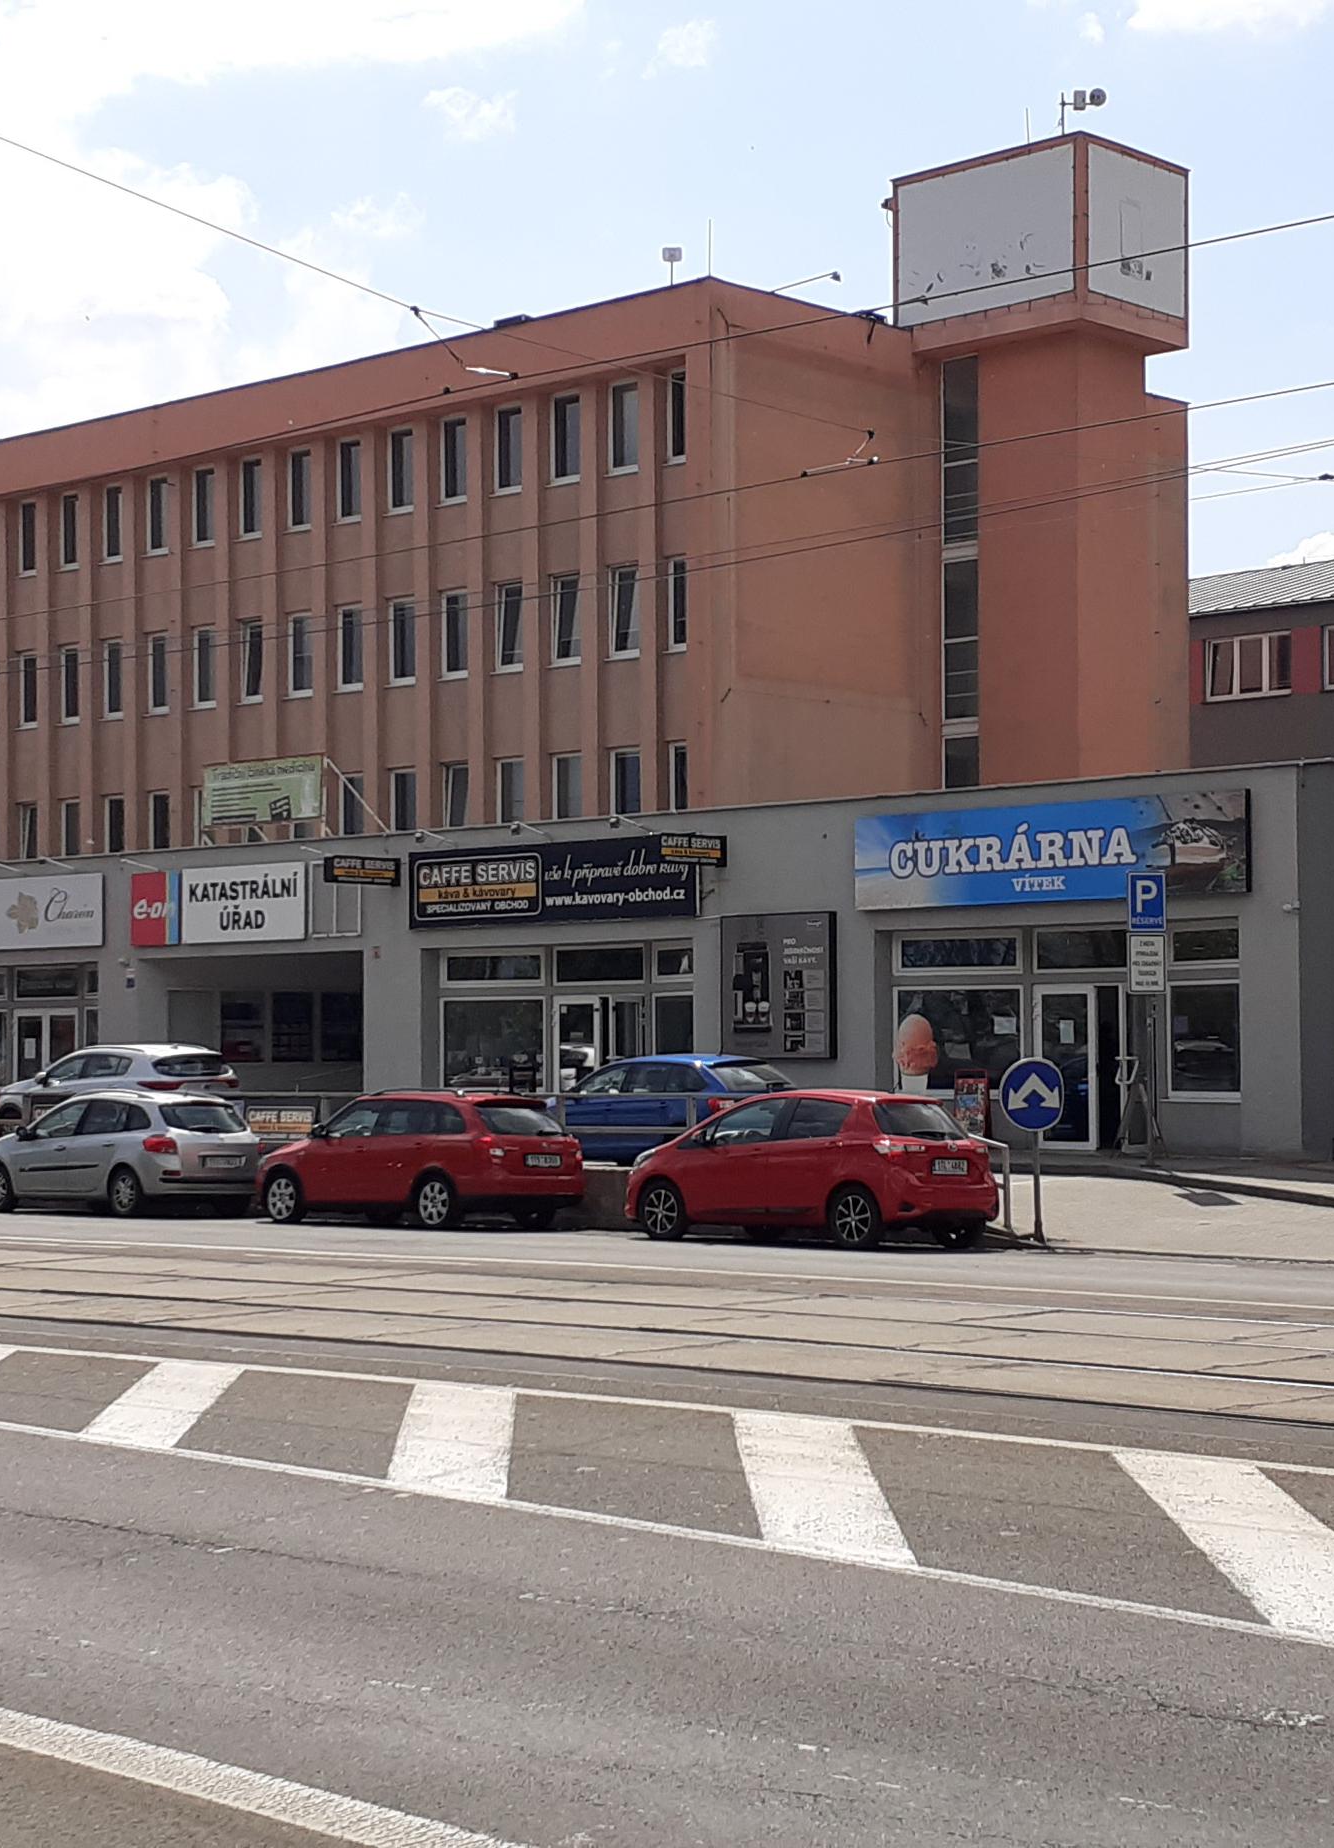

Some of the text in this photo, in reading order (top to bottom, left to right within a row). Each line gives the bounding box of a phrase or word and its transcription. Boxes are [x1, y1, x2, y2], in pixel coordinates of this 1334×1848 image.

[661, 836, 721, 849] CAFFE SERVIS
[889, 821, 1137, 878] CUKRÁRNA
[334, 858, 362, 869] CAFFE
[418, 860, 536, 887] CAFFE SERVIS
[1011, 874, 1066, 892] VÍTEK
[188, 871, 299, 903] KATASTRÁLNÍ
[438, 888, 460, 899] káva
[472, 886, 517, 900] kávovary
[545, 886, 686, 907] www.kavovary-obchod.cz
[1136, 880, 1158, 913] P
[494, 899, 529, 911] OBCHOD
[219, 905, 266, 932] ÚŘAD
[249, 1110, 279, 1122] CAFFE
